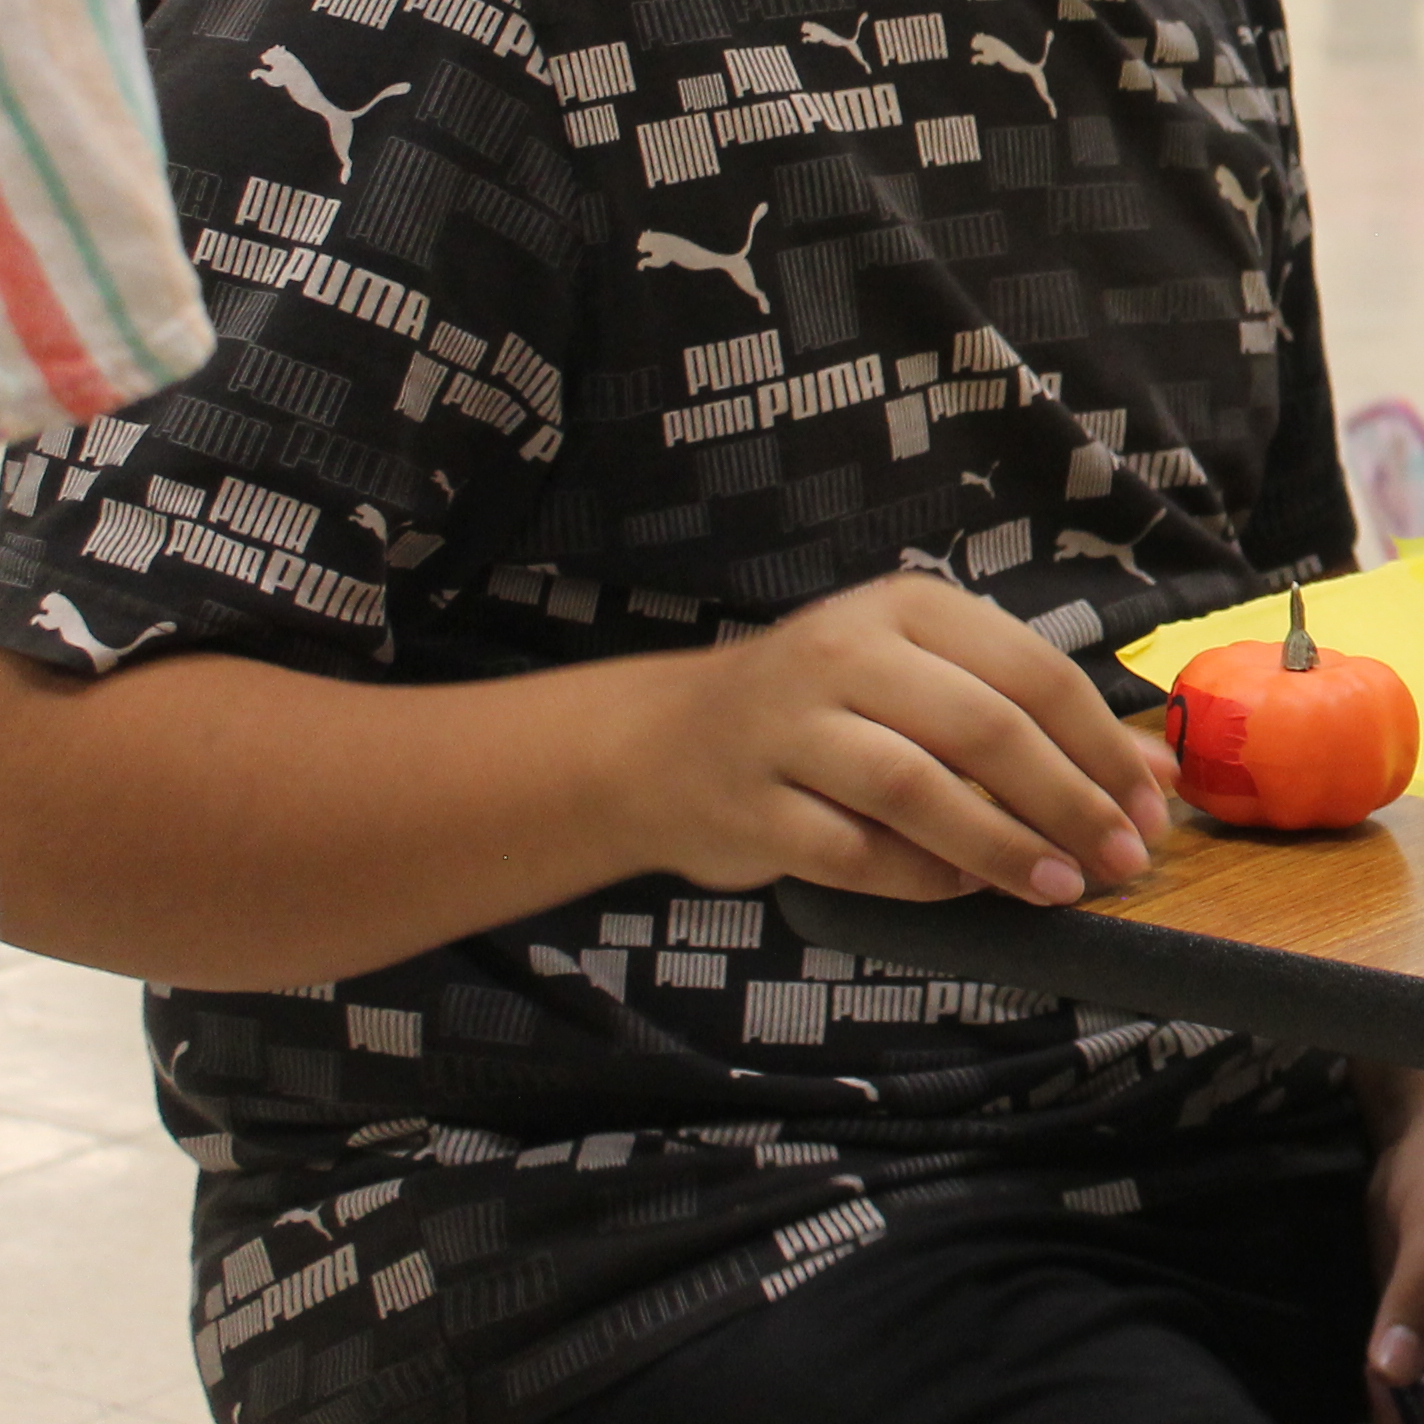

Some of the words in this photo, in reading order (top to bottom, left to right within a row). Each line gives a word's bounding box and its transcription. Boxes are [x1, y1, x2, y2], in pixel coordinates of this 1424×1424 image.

[724, 44, 803, 99] PUMA
[873, 11, 949, 67] PUMA
[549, 40, 636, 107] PUMA
[714, 98, 799, 149] PUMA
[790, 82, 903, 134] PUMA
[914, 113, 982, 168] PUMA
[637, 112, 721, 188] PUMA
[234, 176, 342, 246] PUMA
[193, 227, 288, 288] PUMA
[276, 247, 432, 342] PUMA
[682, 329, 785, 396] PUMA
[441, 372, 527, 436] PUMA
[662, 394, 756, 448] PUMA
[757, 352, 885, 429] PUMA
[927, 378, 1008, 423] PUMA
[80, 496, 168, 574] PUMA
[209, 475, 321, 554] PUMA
[966, 516, 1033, 579] PUMA
[165, 518, 266, 584] PUMA
[667, 899, 765, 948] PUMA
[655, 952, 727, 989] PUMA
[832, 985, 922, 1022] PUMA
[743, 981, 827, 1044] PUMA
[262, 1243, 359, 1332] PUMA
